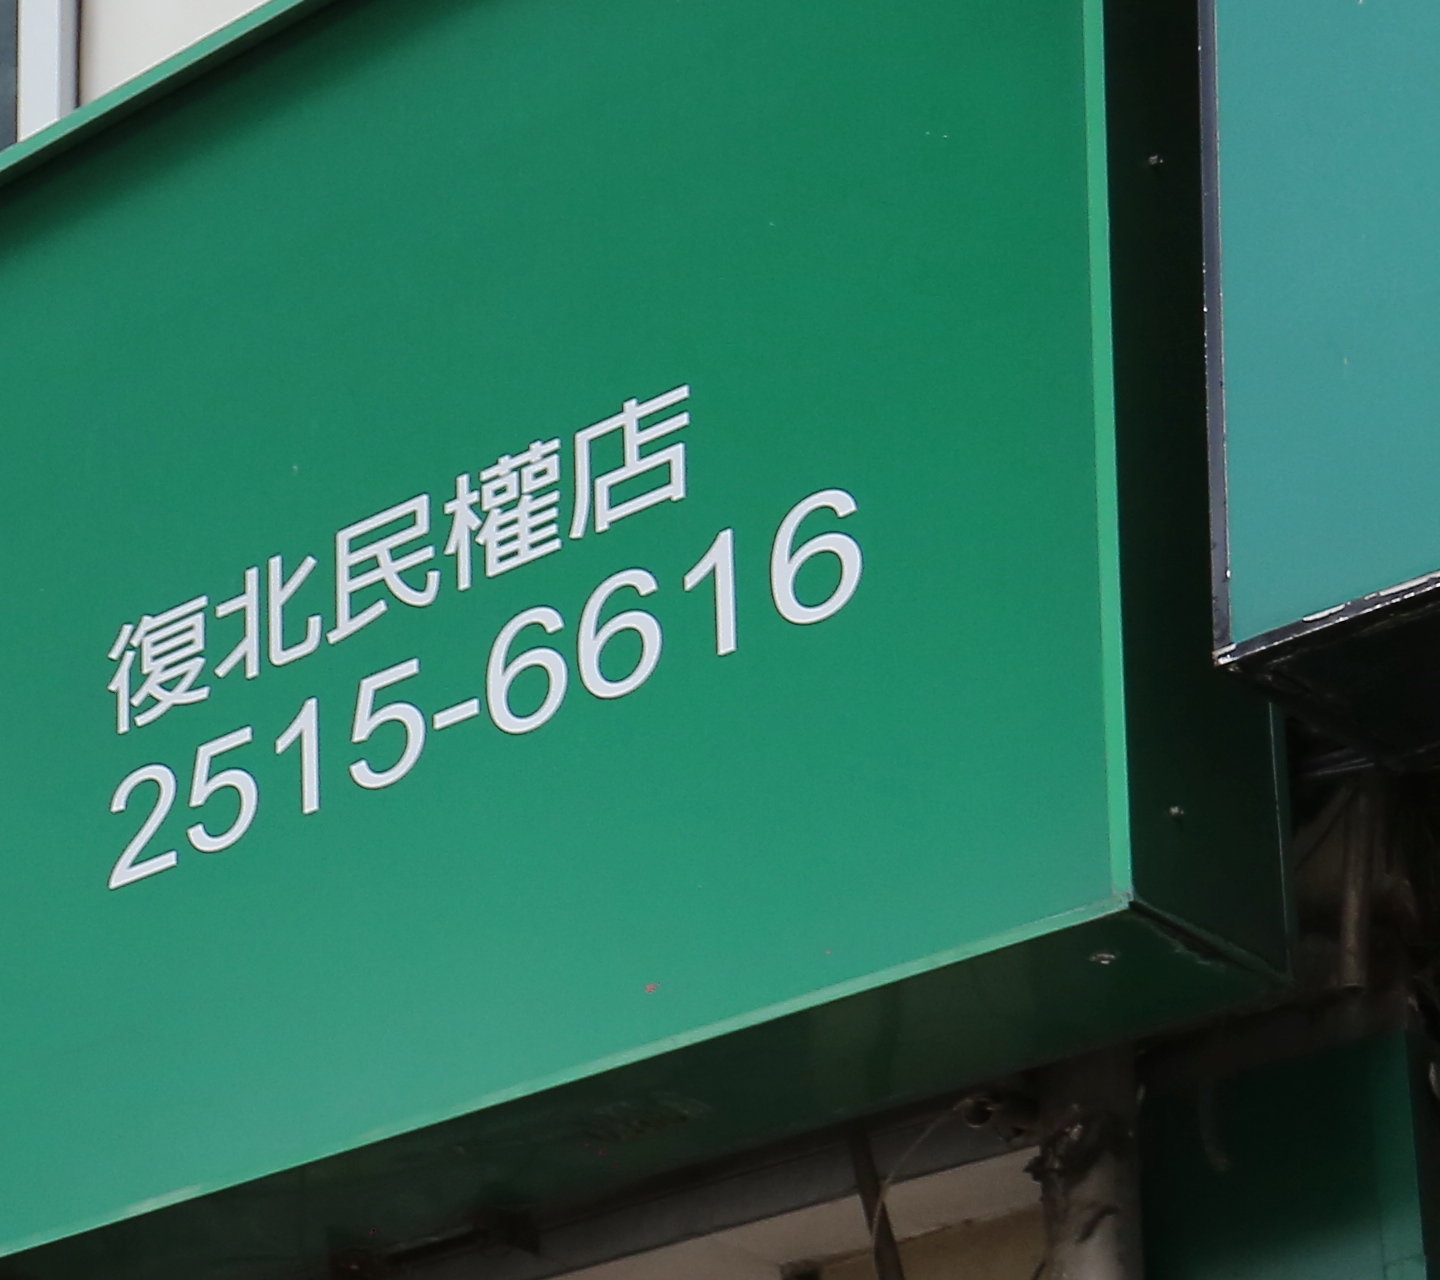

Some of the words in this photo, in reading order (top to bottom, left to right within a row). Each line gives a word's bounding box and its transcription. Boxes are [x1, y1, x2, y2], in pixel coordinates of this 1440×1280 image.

[106, 383, 690, 735] 復北民權店
[107, 488, 865, 889] 2515-6616
